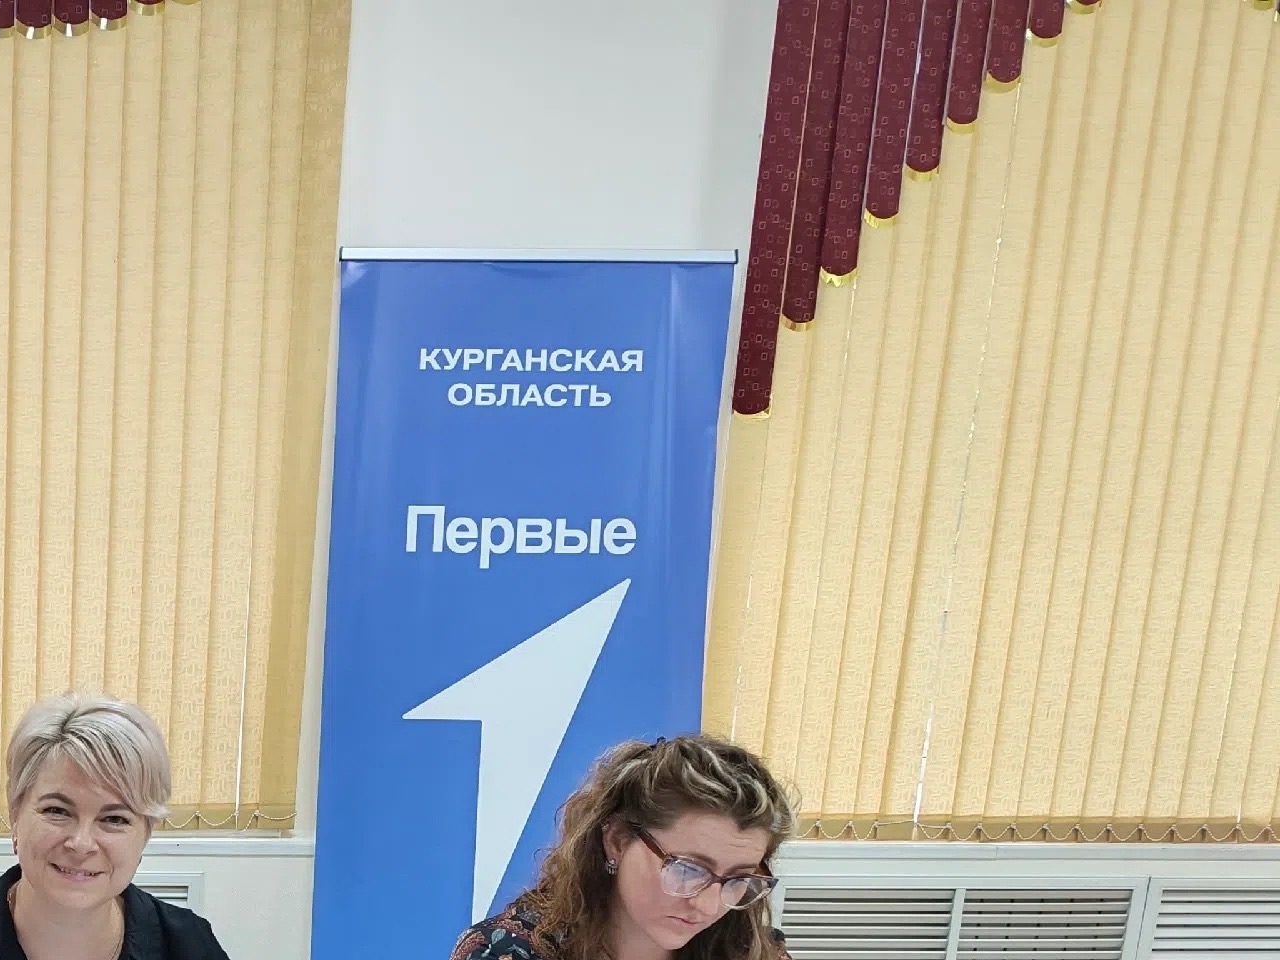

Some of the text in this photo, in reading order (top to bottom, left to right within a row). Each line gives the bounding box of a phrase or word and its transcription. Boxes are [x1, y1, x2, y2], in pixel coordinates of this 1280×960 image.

[419, 348, 644, 372] КУРГАНСКАЯ
[447, 382, 611, 407] ОБЛАСТЬ
[406, 505, 637, 569] Первые
